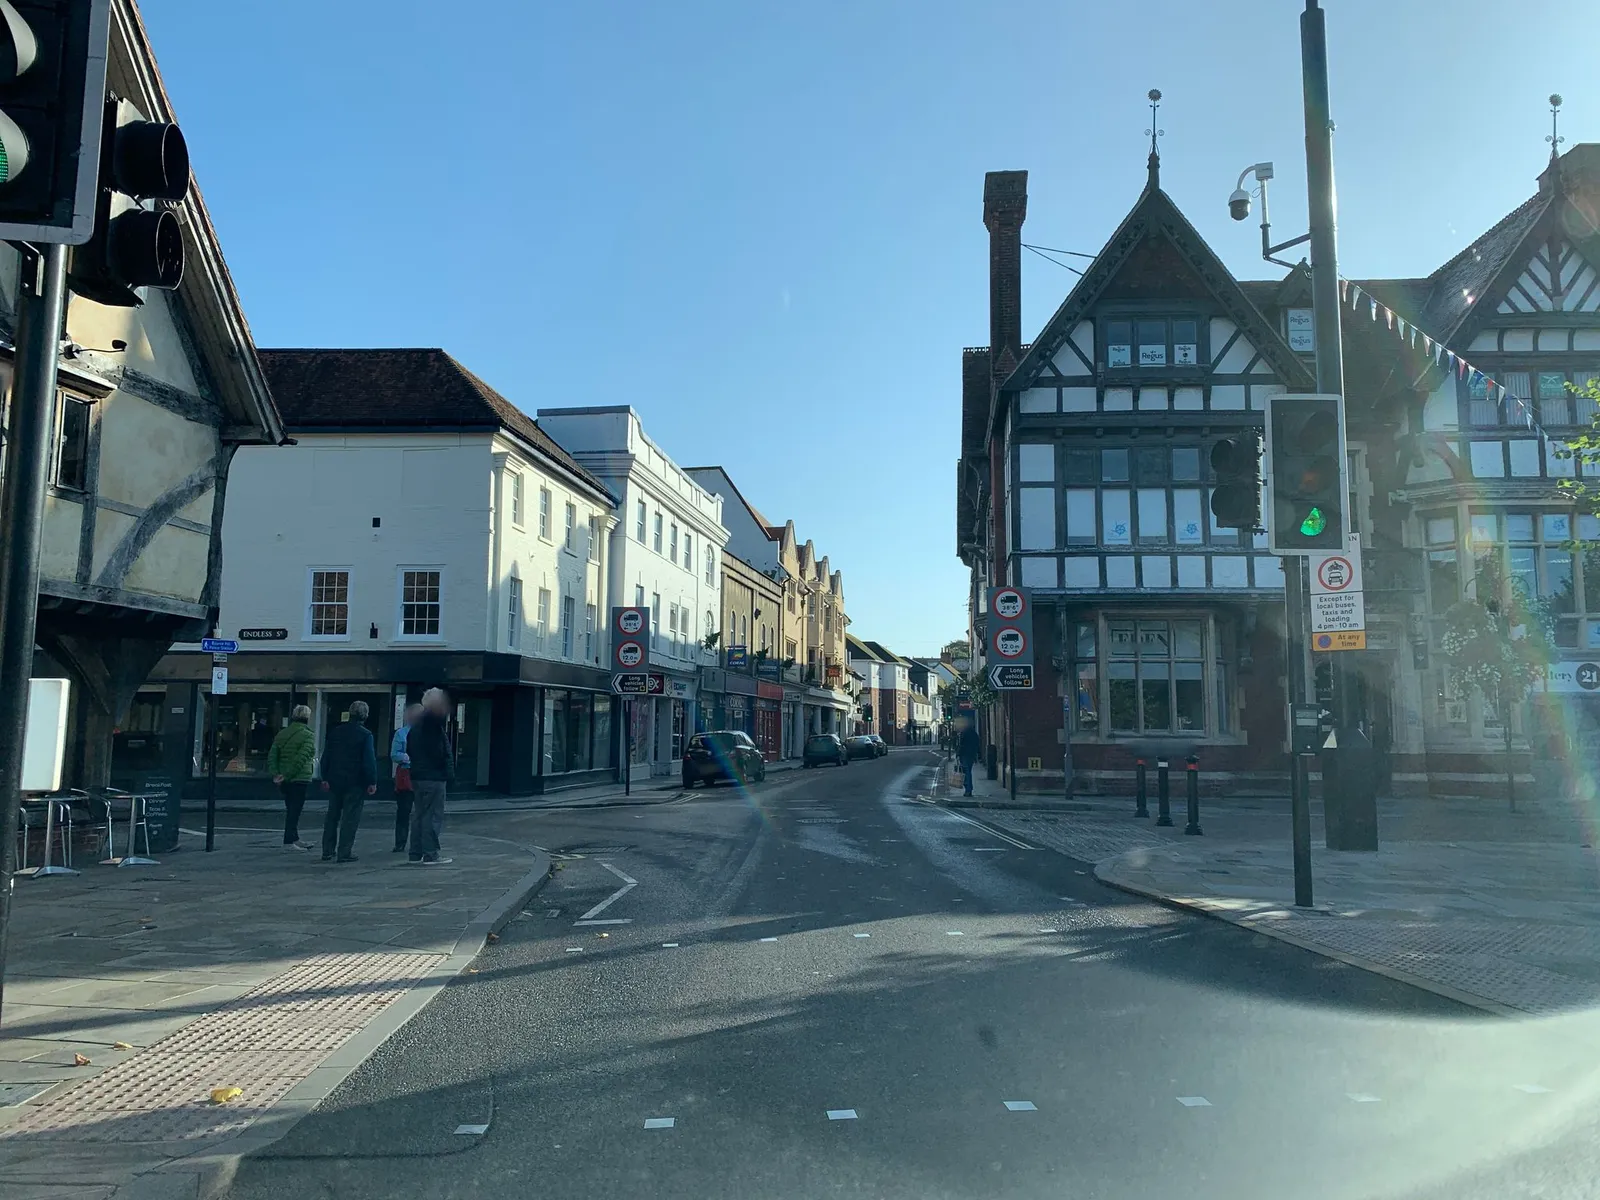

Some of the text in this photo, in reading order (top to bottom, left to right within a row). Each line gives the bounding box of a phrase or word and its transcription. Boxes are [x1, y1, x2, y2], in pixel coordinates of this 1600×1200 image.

[1290, 316, 1310, 326] Regus
[1291, 337, 1311, 346] Regus
[1141, 352, 1164, 361] Regus
[1319, 595, 1343, 603] Except
[1581, 669, 1597, 683] 21
[1031, 760, 1039, 768] H
